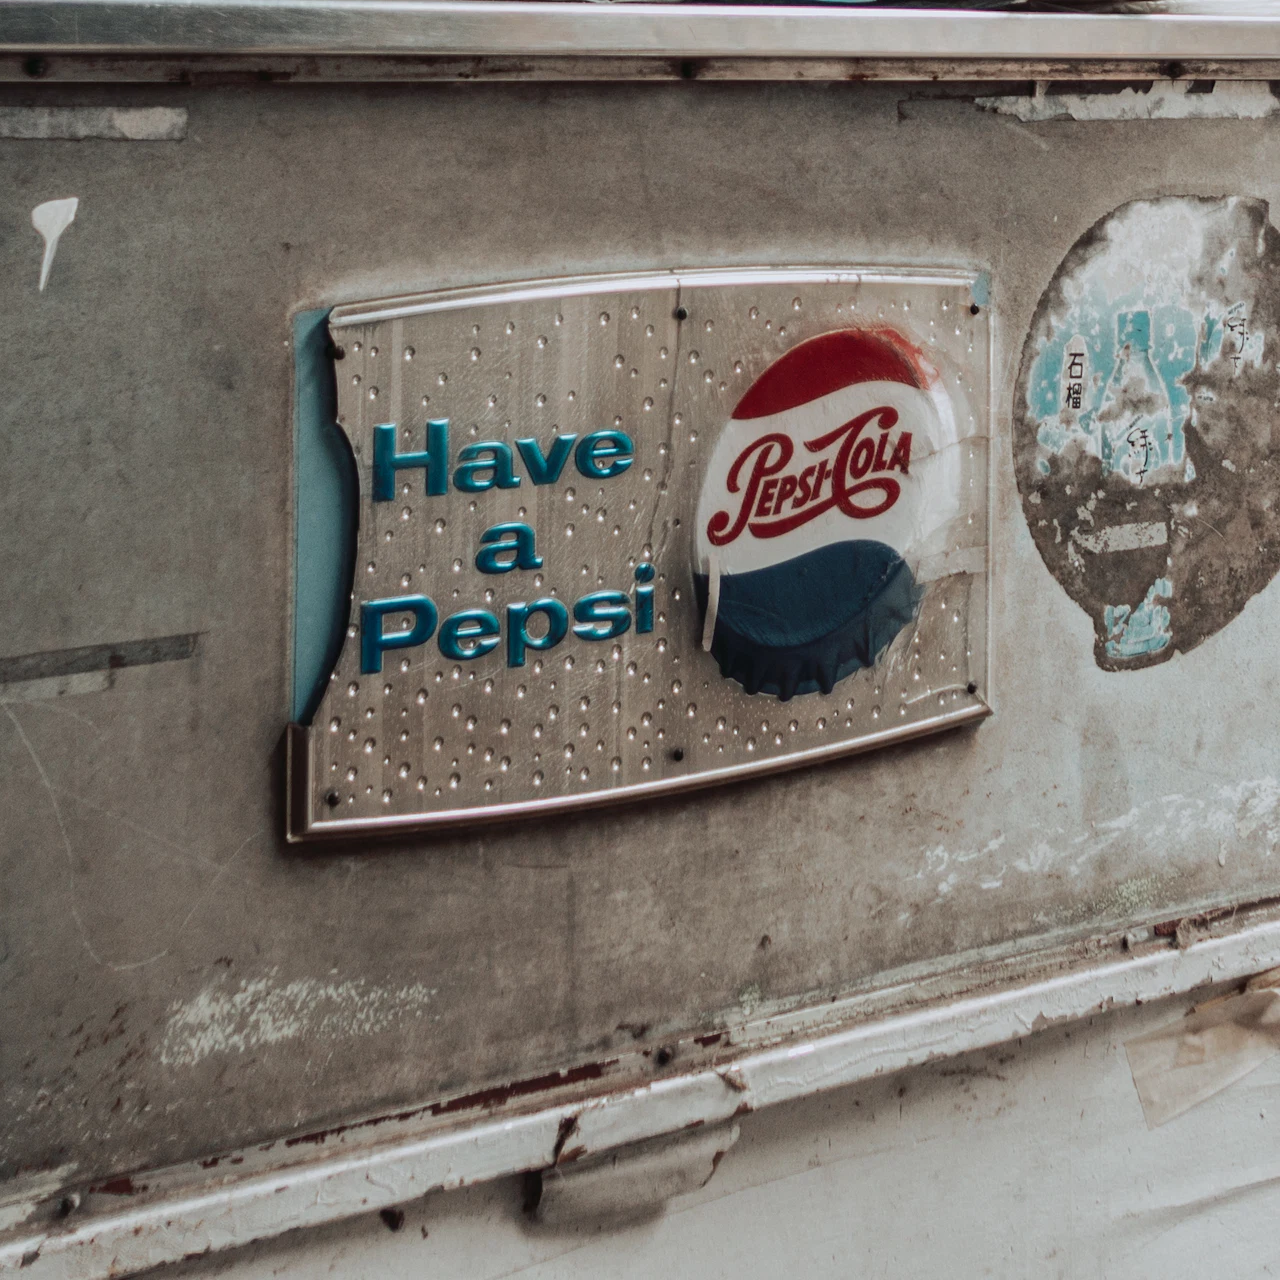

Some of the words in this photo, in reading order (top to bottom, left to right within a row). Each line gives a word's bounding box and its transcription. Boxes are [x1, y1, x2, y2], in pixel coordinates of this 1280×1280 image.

[1065, 352, 1085, 409] 石榴
[372, 417, 635, 502] Have
[475, 520, 543, 575] a
[359, 561, 656, 675] Pepsi
